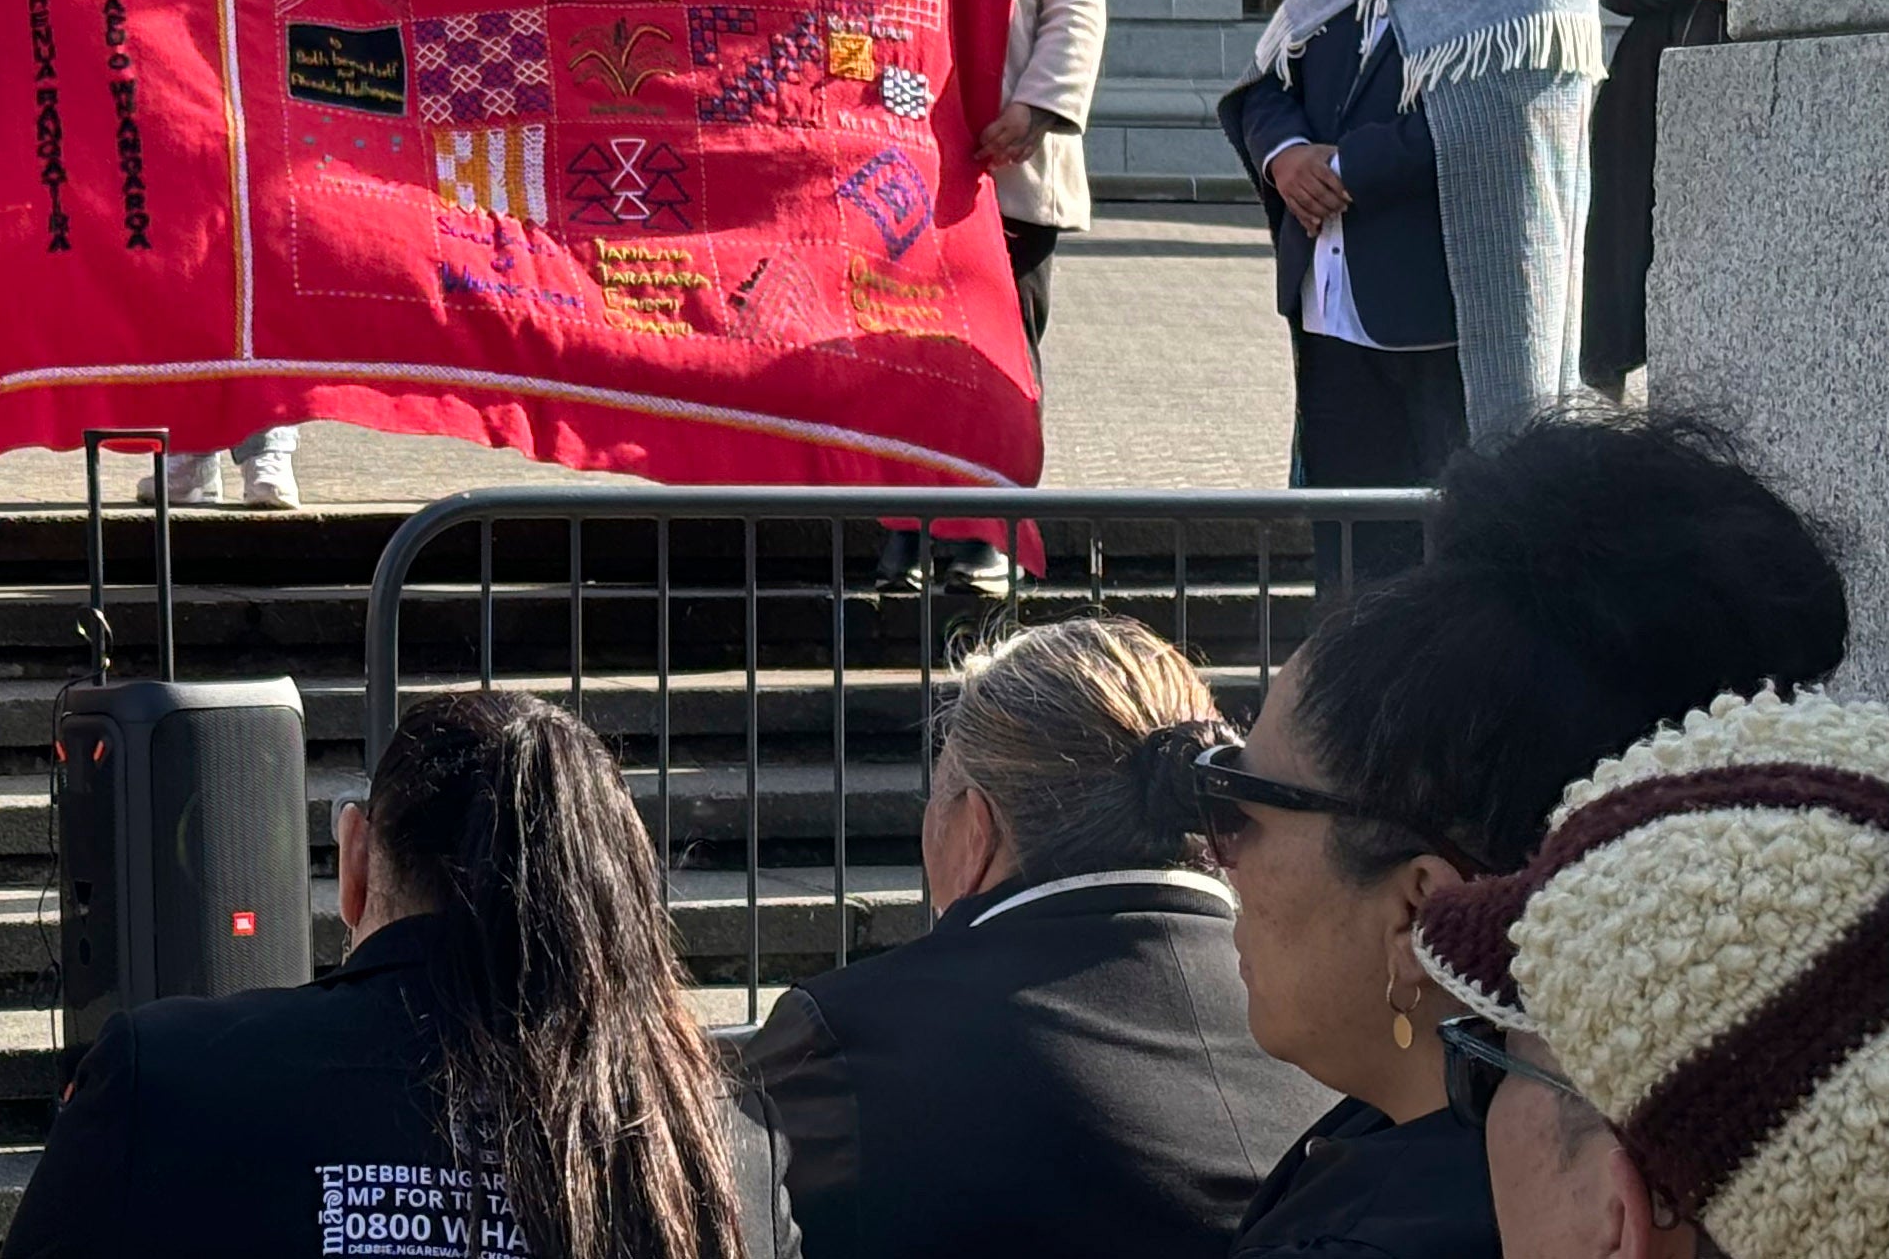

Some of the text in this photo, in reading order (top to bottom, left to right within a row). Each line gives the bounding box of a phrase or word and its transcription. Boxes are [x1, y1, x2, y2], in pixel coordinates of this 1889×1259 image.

[346, 1163, 433, 1186] DEBBIE
[314, 1163, 344, 1257] māori
[346, 1186, 387, 1207] MP
[394, 1188, 444, 1211] FOR
[345, 1212, 432, 1242] 0800
